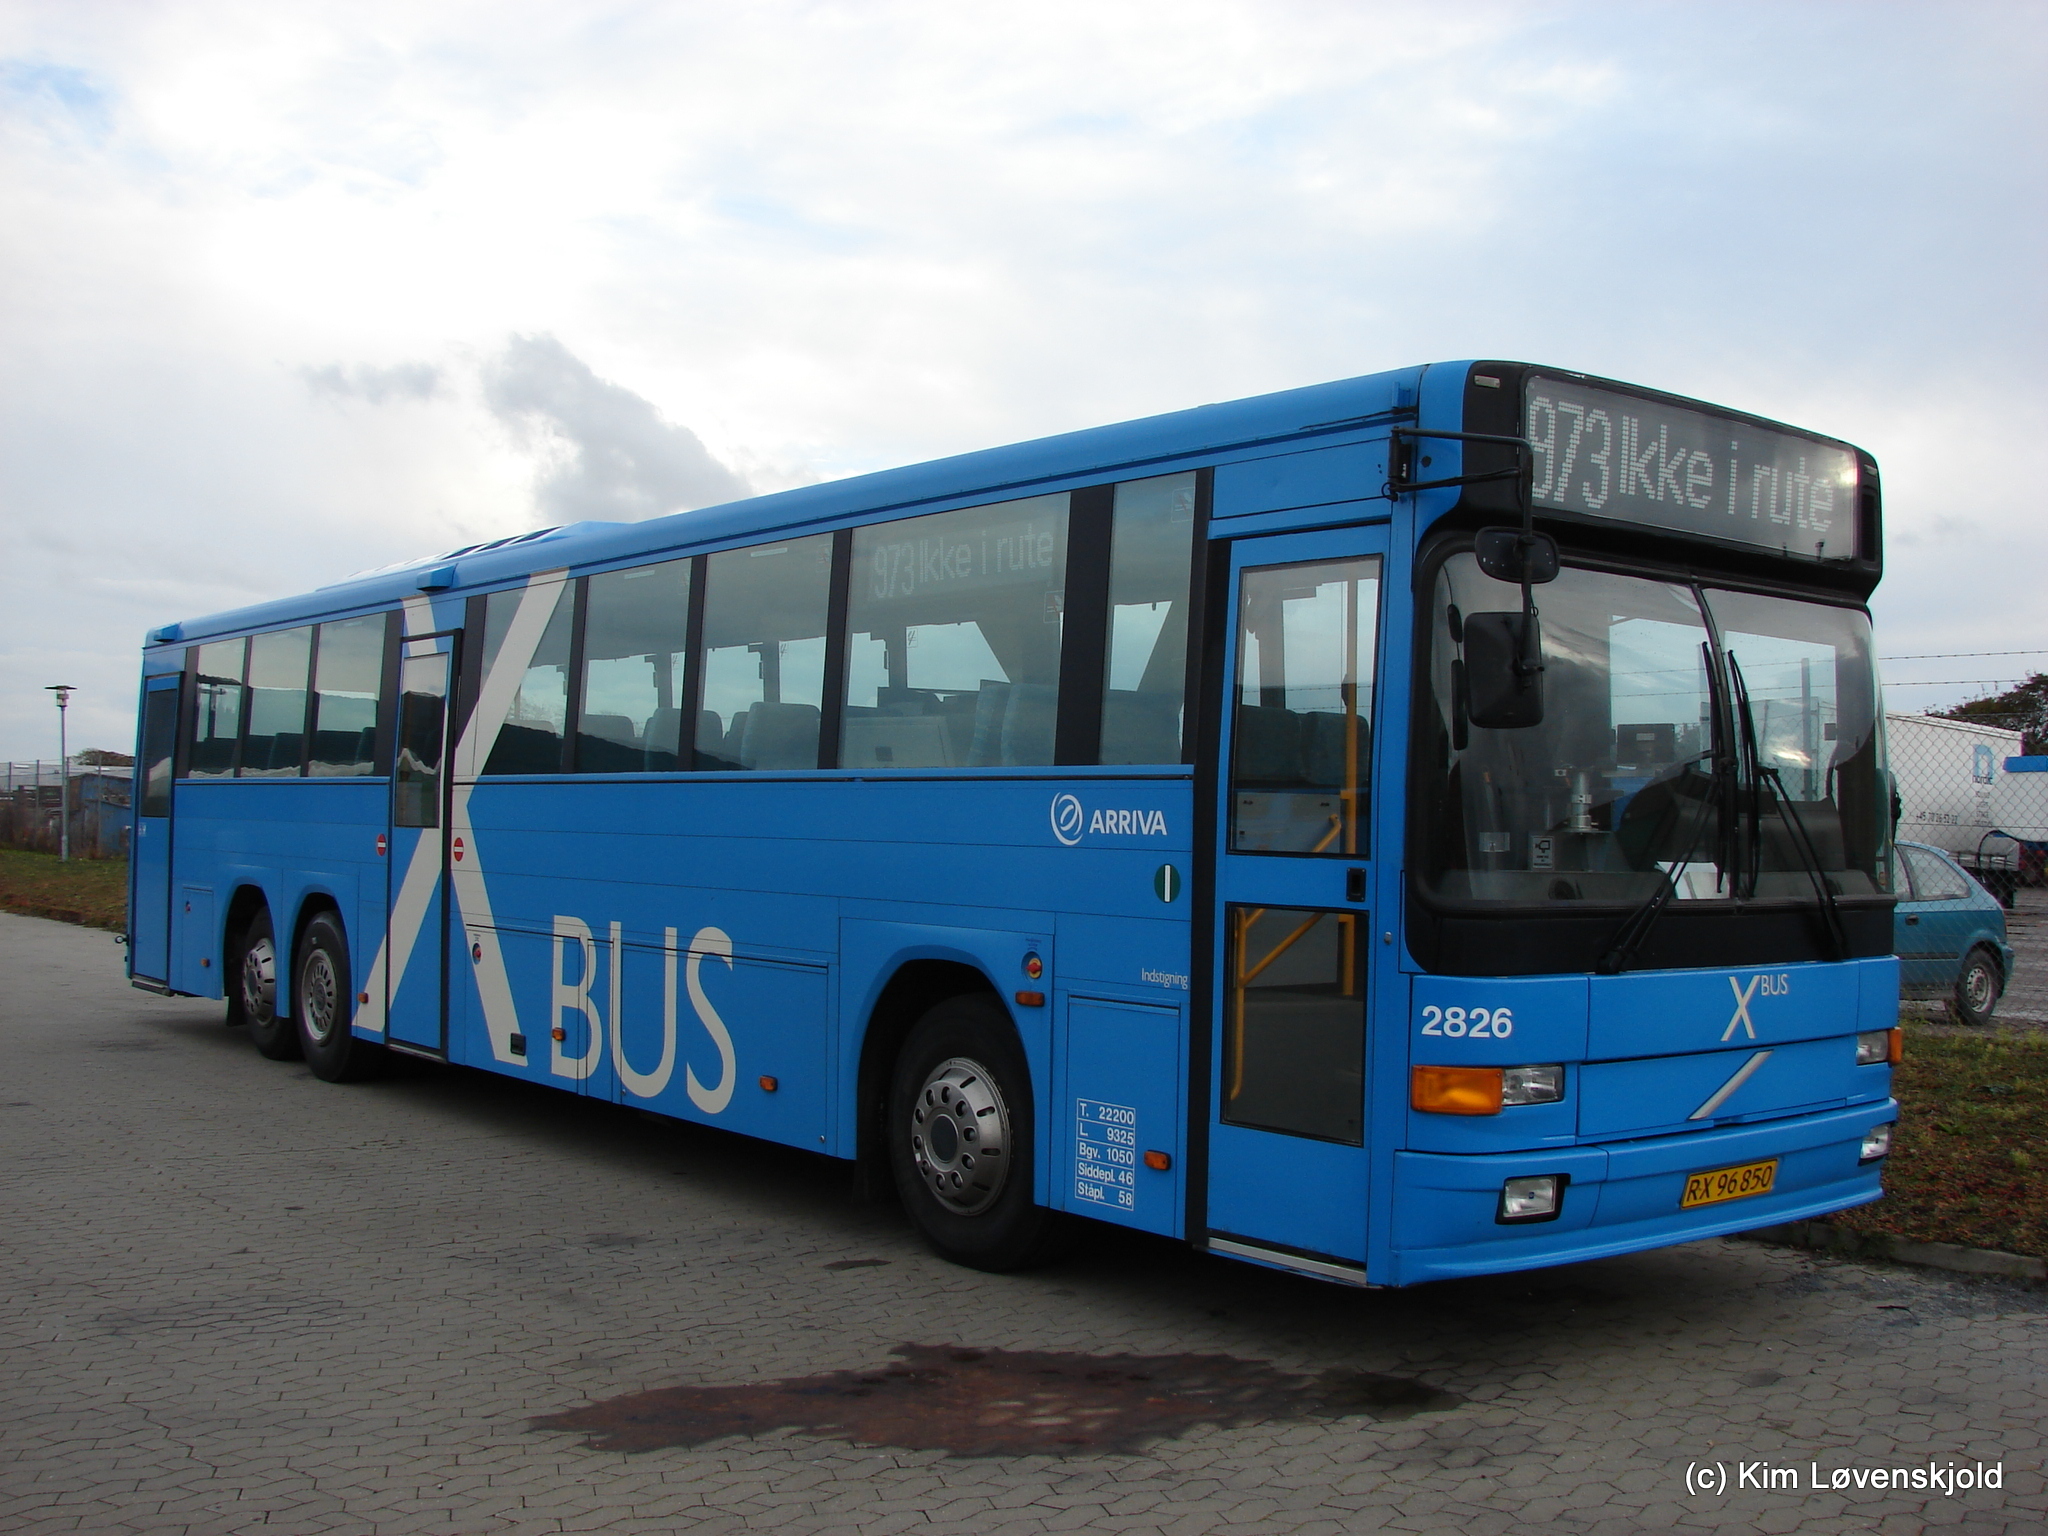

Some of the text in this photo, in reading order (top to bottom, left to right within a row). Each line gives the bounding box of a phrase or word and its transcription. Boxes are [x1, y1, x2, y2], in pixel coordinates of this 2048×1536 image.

[1529, 396, 1834, 532] 973 Ikke i rute
[872, 523, 1054, 599] 973 Ikke i rute
[1089, 809, 1167, 836] ARRIVA
[1141, 967, 1188, 990] Indstigning
[1760, 973, 1789, 996] BUS
[551, 914, 737, 1115] BUS
[1421, 1006, 1512, 1038] 2826
[1080, 1103, 1134, 1125] T. 22200
[1107, 1127, 1134, 1145] 9325
[1079, 1142, 1133, 1165] Bgv. 1050
[1078, 1162, 1133, 1185] Siddepl. 46
[1686, 1165, 1773, 1201] RX 96 850
[1078, 1181, 1132, 1206] Ståpl. 58
